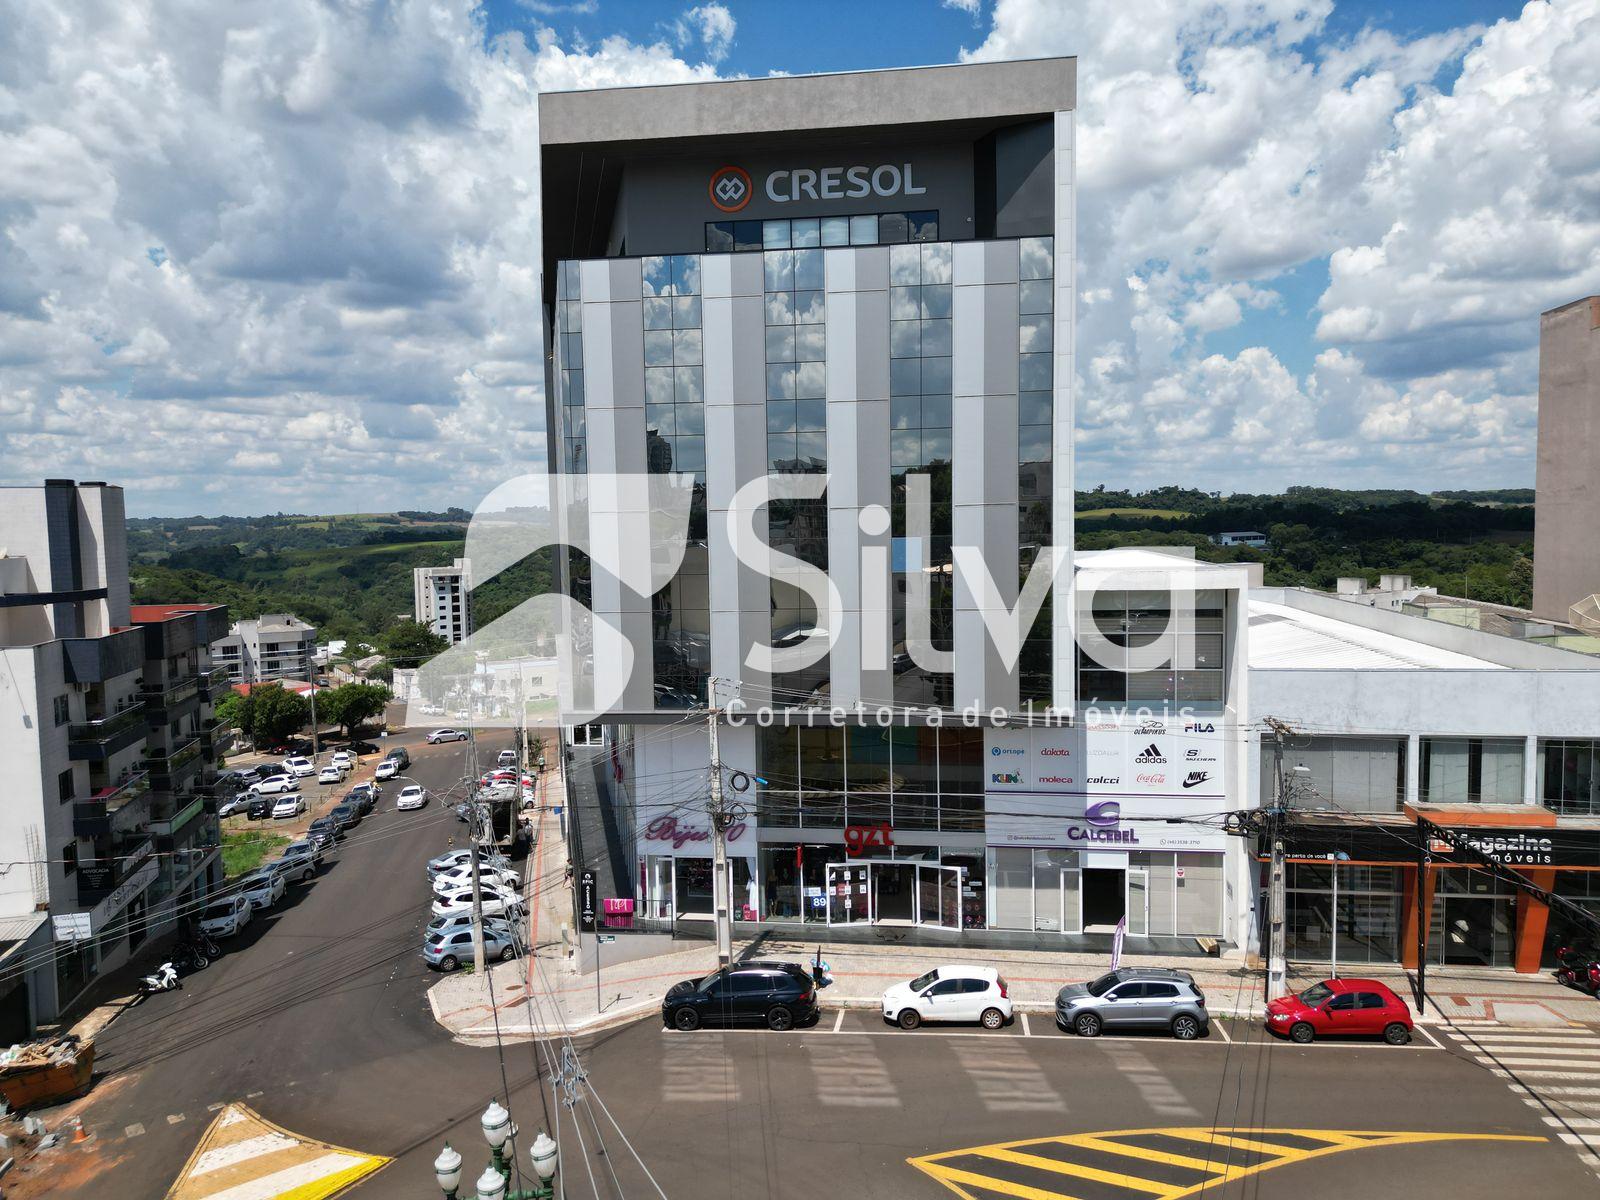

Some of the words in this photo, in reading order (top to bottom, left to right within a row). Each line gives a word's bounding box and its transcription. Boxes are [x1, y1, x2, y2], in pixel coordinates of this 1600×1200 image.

[765, 163, 927, 203] CRESOL
[1184, 723, 1215, 733] FILA
[1040, 748, 1070, 757] dakota
[1135, 756, 1168, 764] adidas
[1038, 776, 1073, 784] moleca
[1086, 776, 1120, 784] colcci
[1186, 771, 1208, 781] NIKE
[844, 821, 895, 856] gzt
[1067, 826, 1140, 845] CALCEBEL
[1490, 853, 1552, 863] móveis
[813, 897, 827, 907] 89
